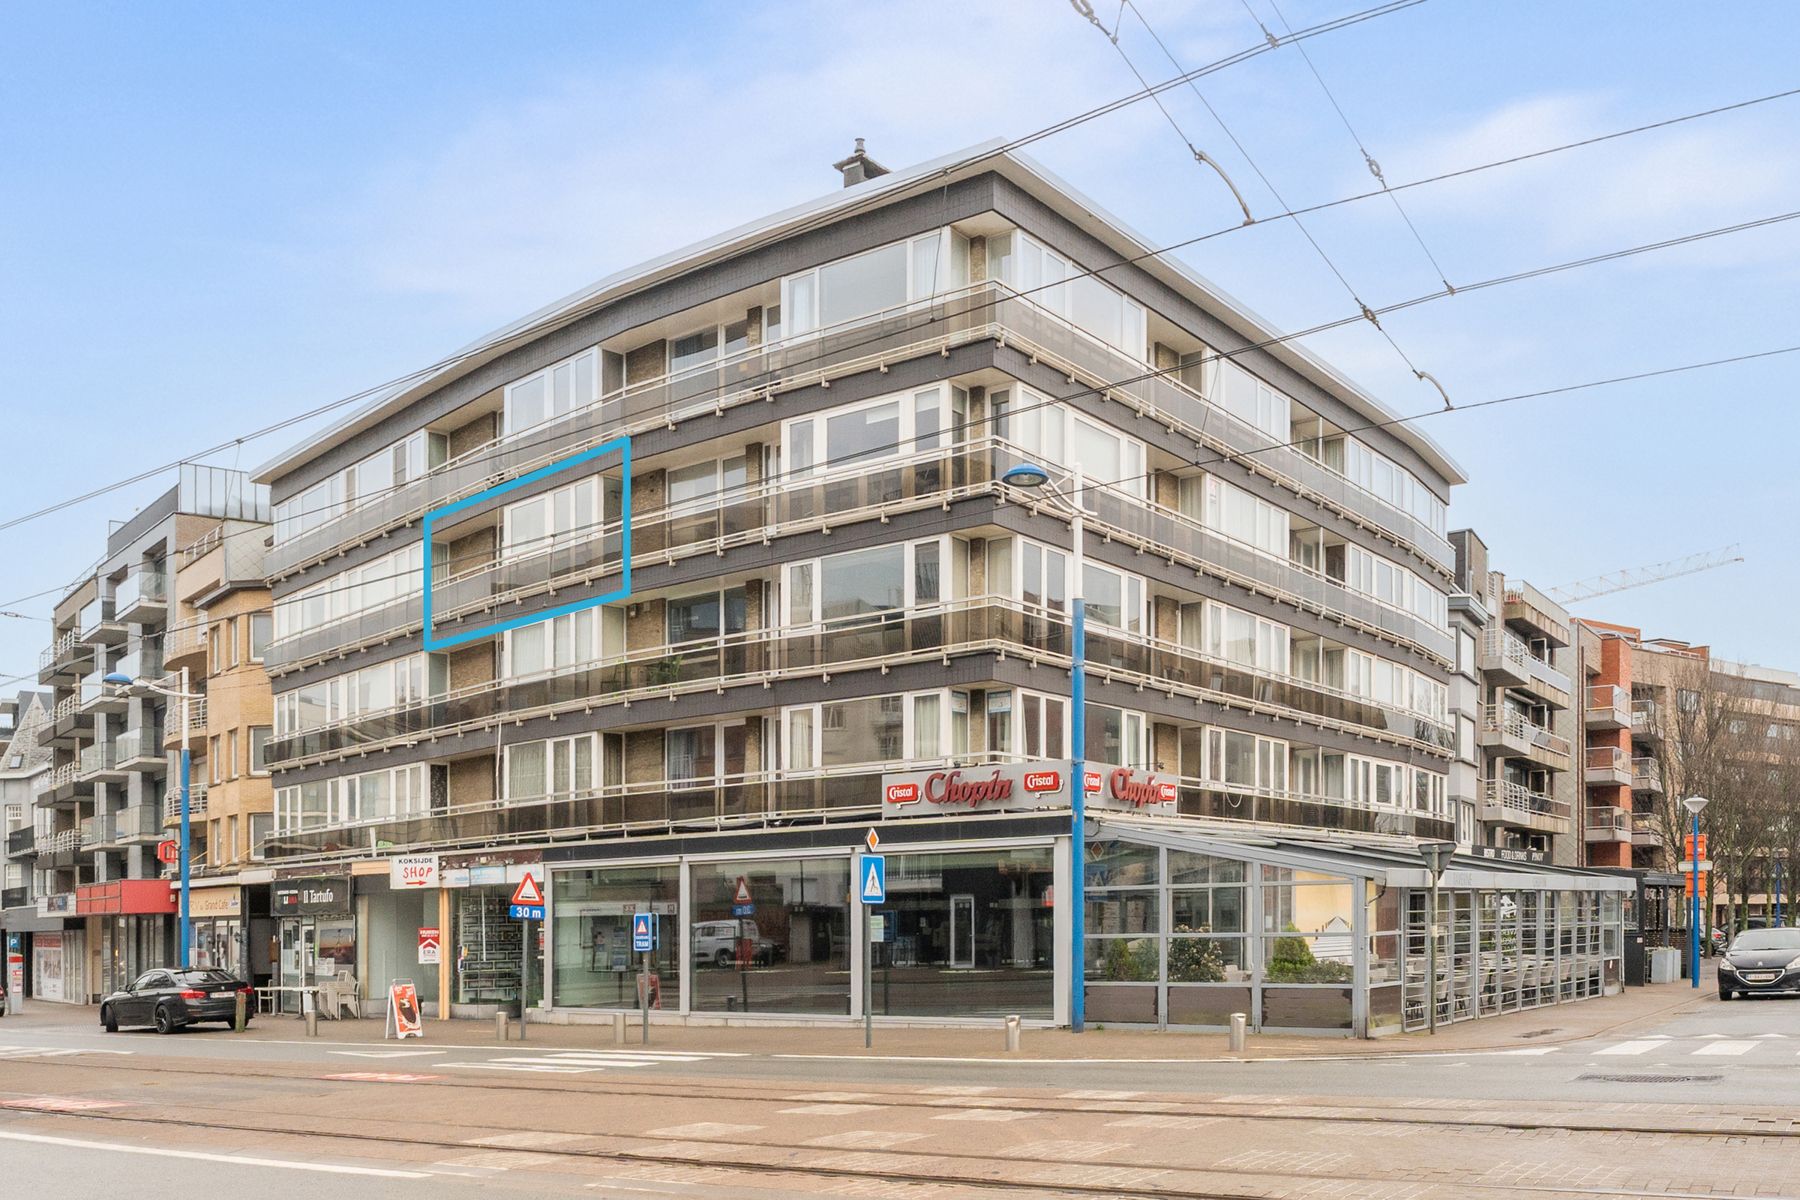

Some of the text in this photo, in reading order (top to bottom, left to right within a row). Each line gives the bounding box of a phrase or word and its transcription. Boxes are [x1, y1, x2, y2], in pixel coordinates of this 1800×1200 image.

[1027, 772, 1054, 788] Cristal
[1084, 774, 1100, 787] Cristal
[889, 787, 913, 800] Cristal
[924, 769, 1013, 808] Chopin
[1161, 785, 1175, 797] Cristal
[398, 857, 433, 865] KOKSIJDE
[403, 866, 433, 878] SHOP
[309, 888, 334, 903] Tartufo
[516, 907, 541, 918] 30 m
